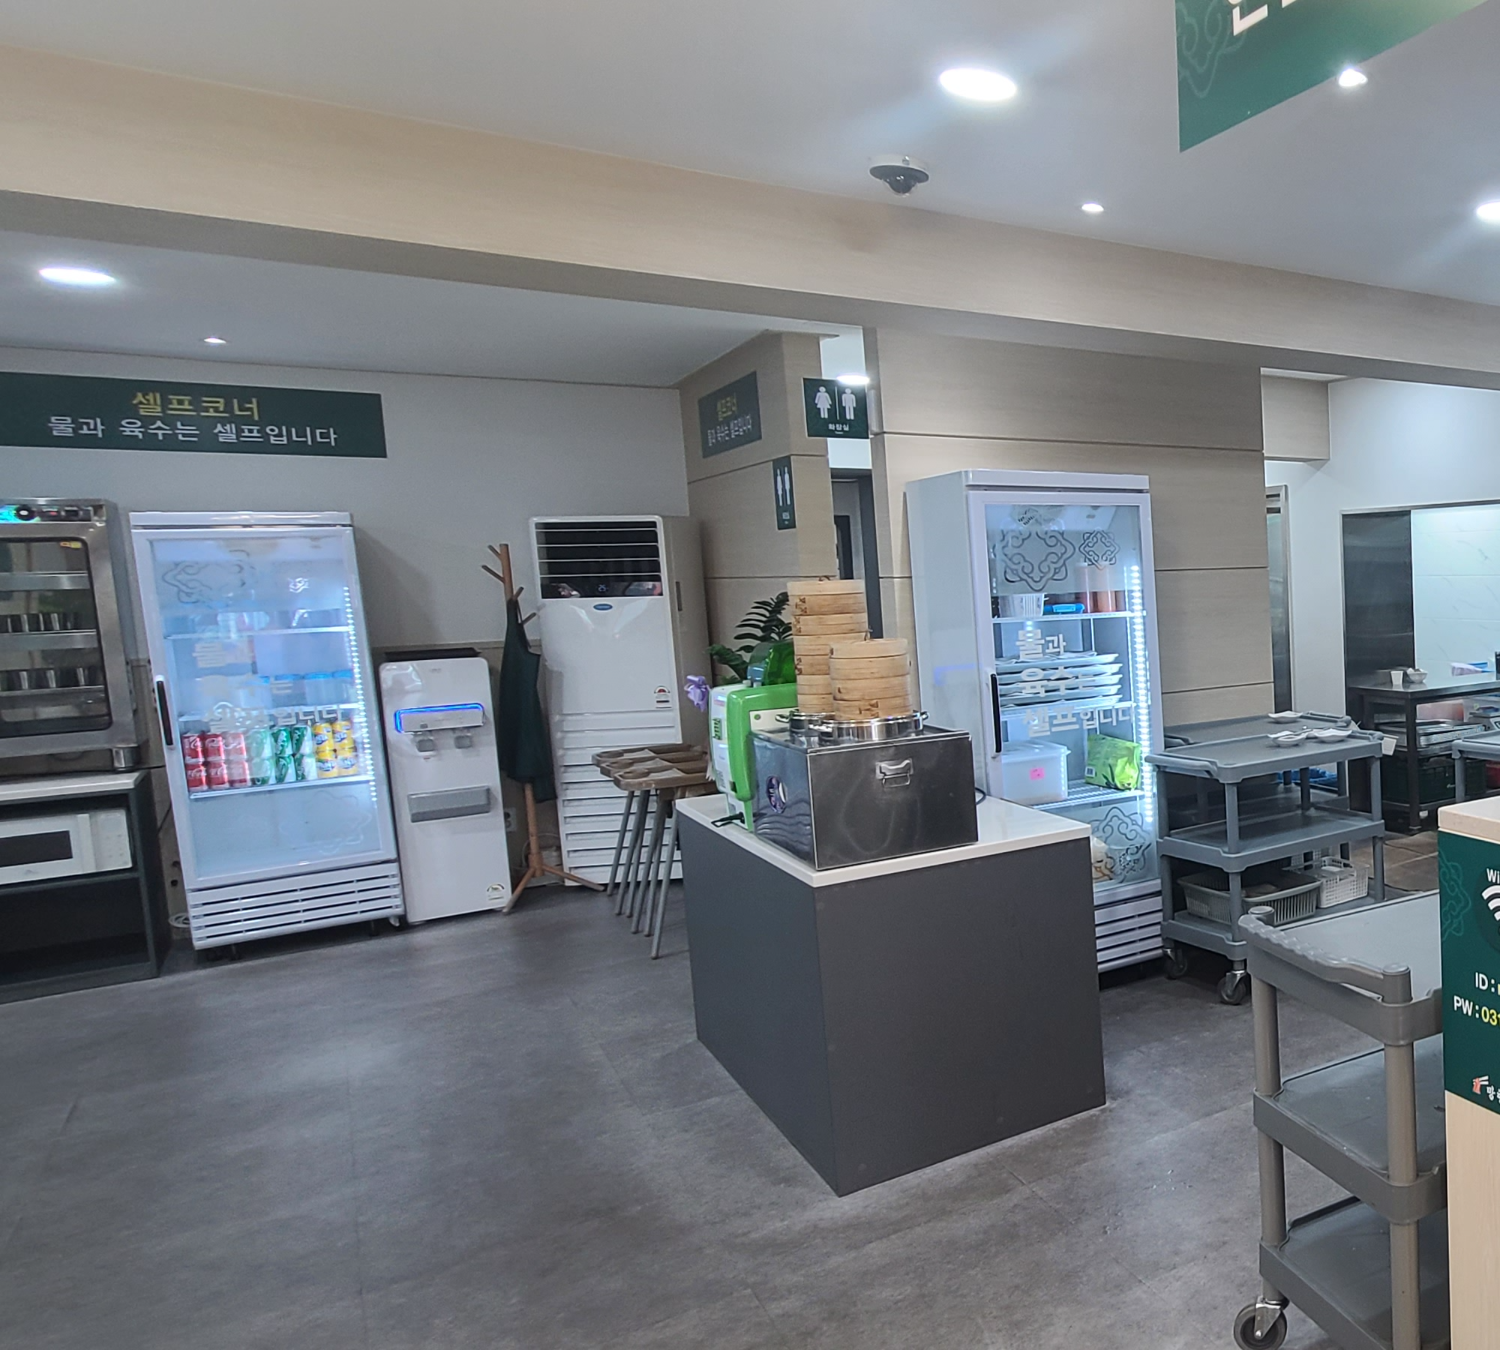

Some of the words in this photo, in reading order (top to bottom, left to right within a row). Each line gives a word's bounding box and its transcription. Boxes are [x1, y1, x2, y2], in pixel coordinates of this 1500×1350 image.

[132, 390, 261, 421] 셀프코너
[48, 416, 106, 438] 물과
[119, 418, 200, 442] 육수는
[213, 422, 338, 447] 셀프입니다
[1015, 628, 1067, 660] 물과
[1020, 665, 1096, 698] 육수는
[1022, 705, 1135, 738] 셀프입니다
